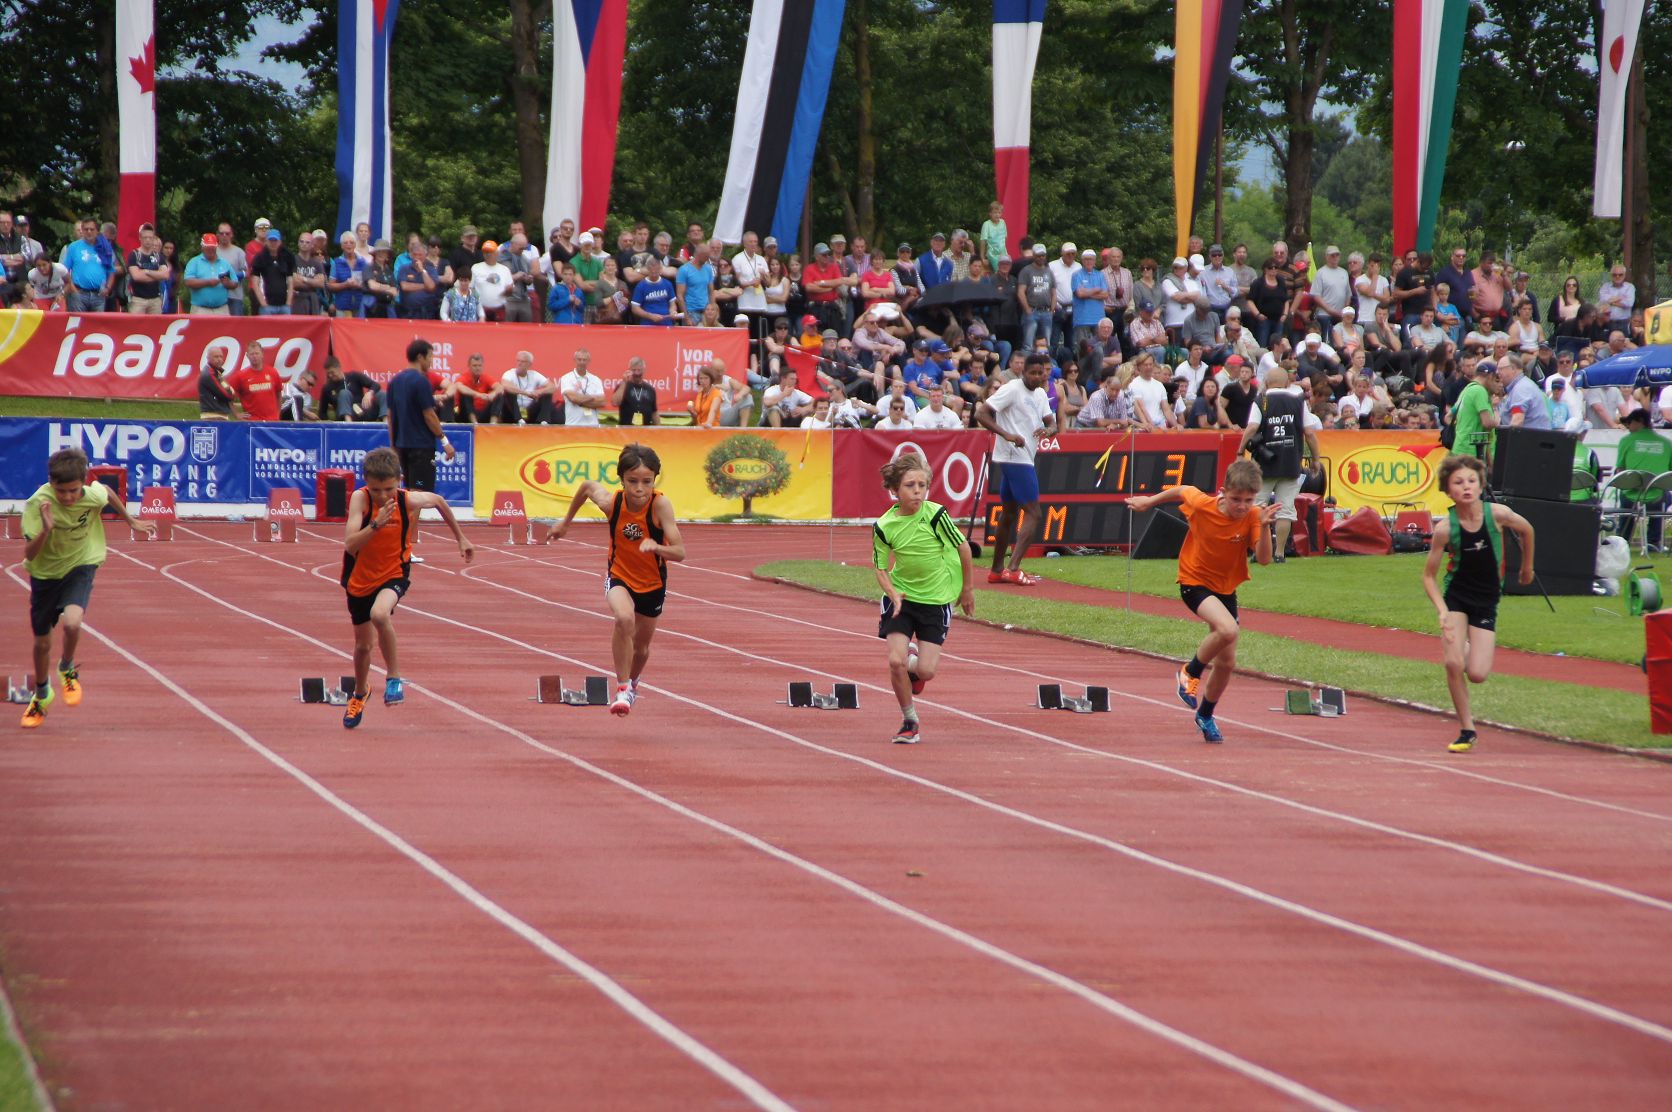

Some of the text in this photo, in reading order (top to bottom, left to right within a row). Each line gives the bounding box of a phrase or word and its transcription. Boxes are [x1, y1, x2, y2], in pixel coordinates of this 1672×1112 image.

[430, 342, 454, 356] OR
[682, 349, 713, 362] VOR
[1273, 425, 1286, 436] 25
[48, 422, 186, 462] HYPO
[255, 447, 306, 463] HYPO
[330, 449, 367, 463] HYP
[254, 463, 317, 471] LANDESBANK
[735, 463, 767, 474] RAUCH
[254, 471, 317, 479] VORARLBERG
[1361, 461, 1420, 485] RAUCH
[141, 505, 174, 514] OMEGA
[270, 508, 302, 516] OMEGA
[493, 508, 525, 517] OMEGA
[624, 522, 639, 532] SG
